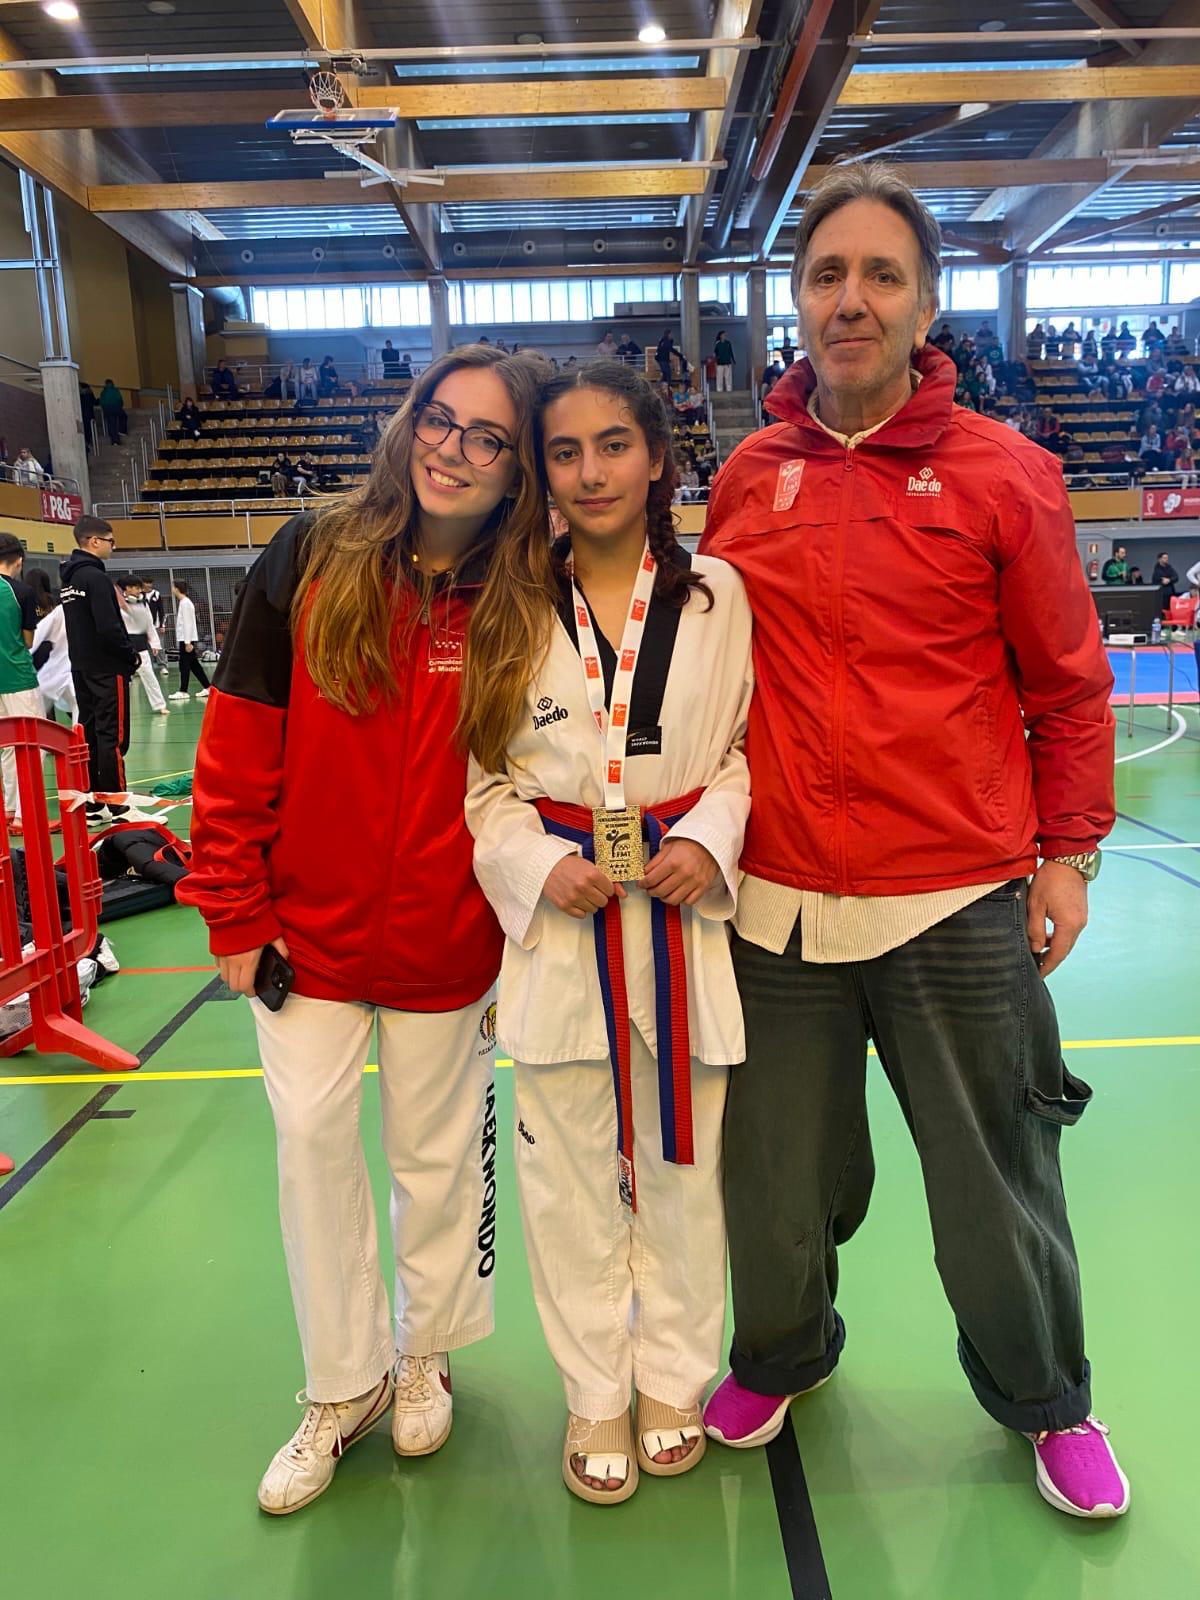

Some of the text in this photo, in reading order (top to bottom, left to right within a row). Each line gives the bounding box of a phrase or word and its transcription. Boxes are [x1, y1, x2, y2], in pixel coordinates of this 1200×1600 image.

[907, 476, 942, 493] Daedo
[50, 495, 72, 520] P&G
[532, 705, 569, 731] Daedo
